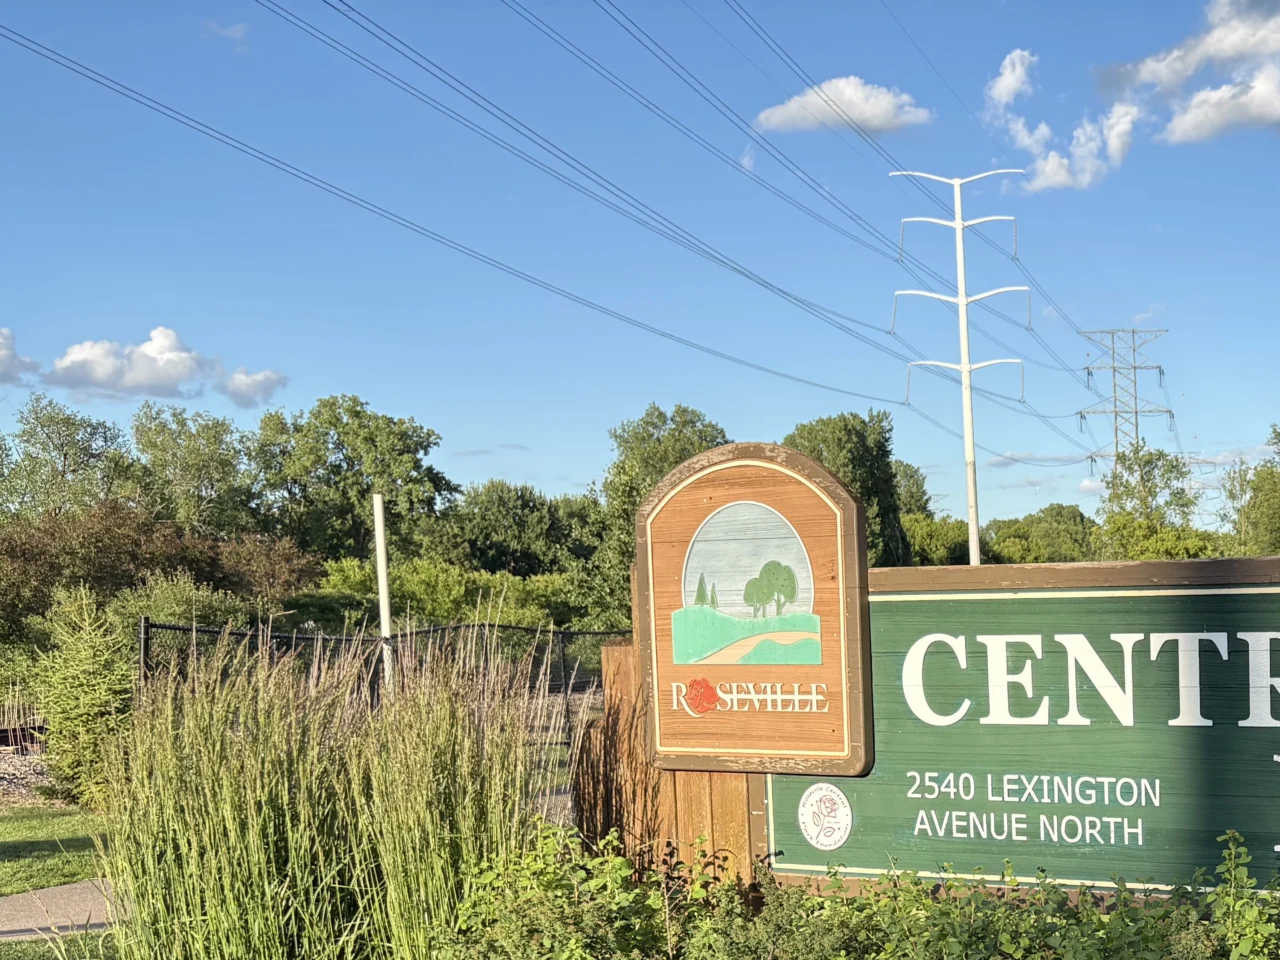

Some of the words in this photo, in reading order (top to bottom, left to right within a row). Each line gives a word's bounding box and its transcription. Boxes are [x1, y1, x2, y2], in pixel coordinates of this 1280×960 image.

[906, 771, 975, 800] 2540
[987, 774, 1161, 807] LEXINGTON
[914, 810, 1027, 840] AVENUE
[1039, 815, 1143, 846] NORTH
